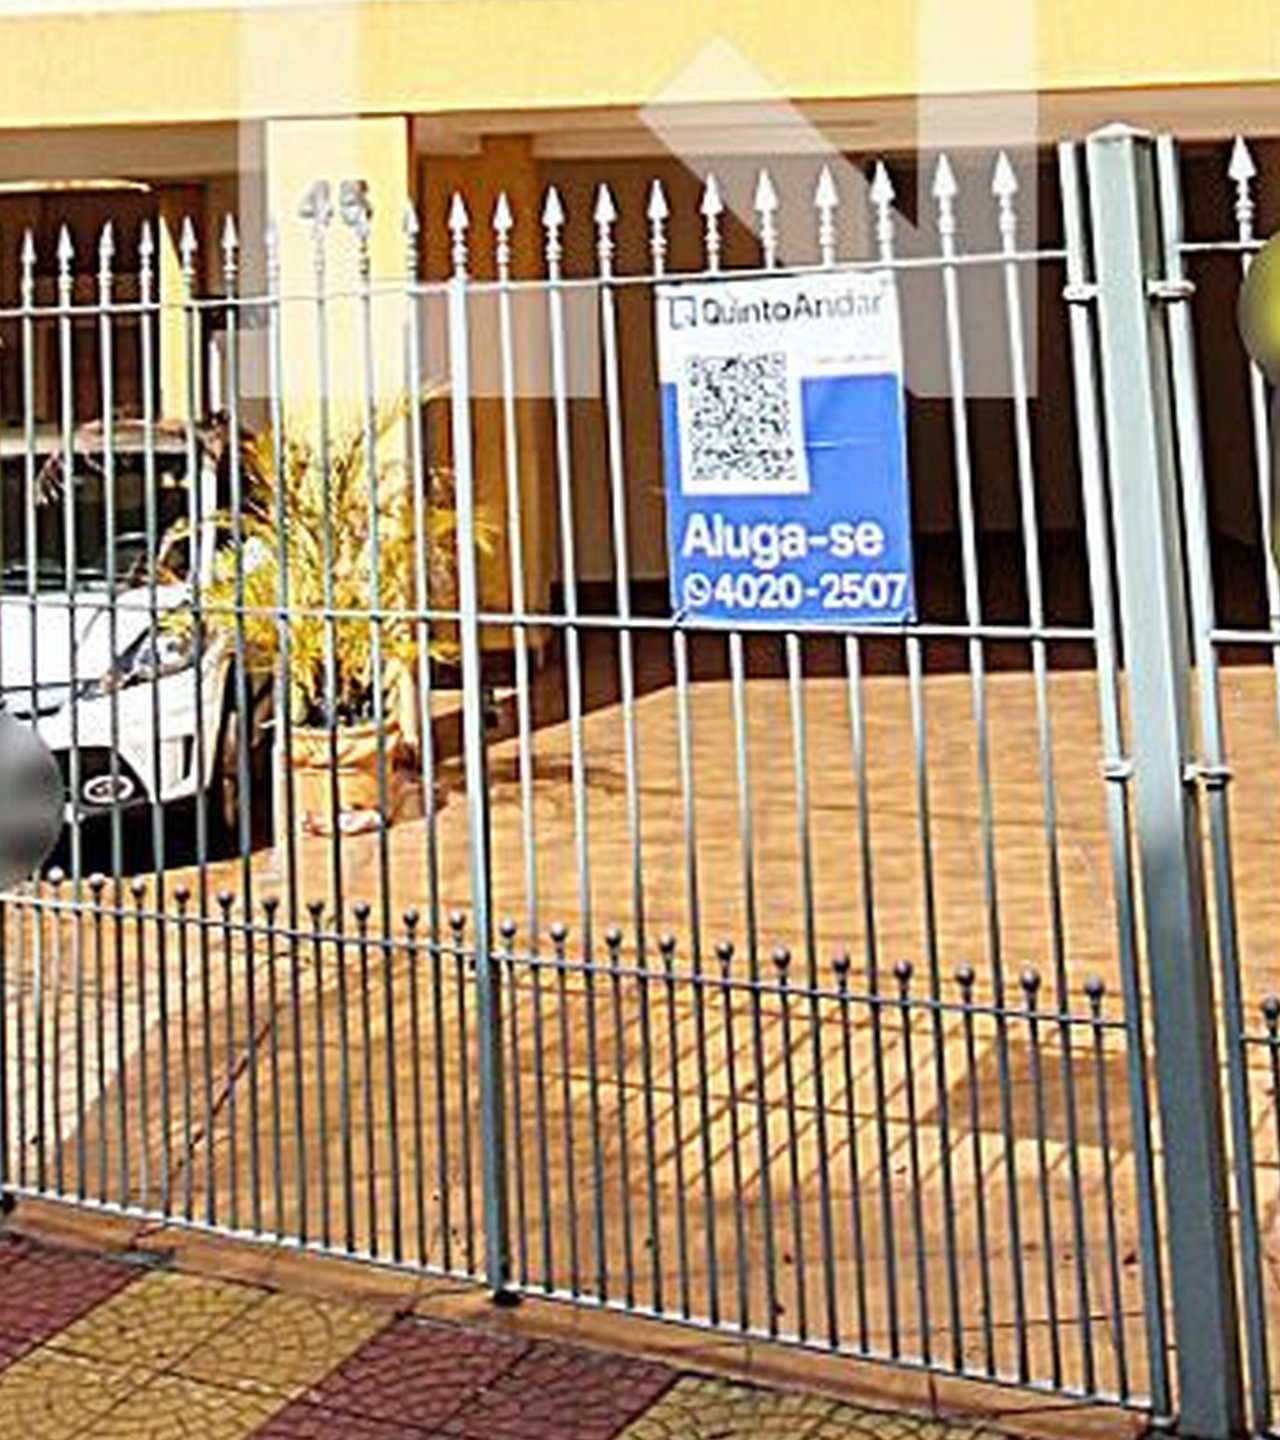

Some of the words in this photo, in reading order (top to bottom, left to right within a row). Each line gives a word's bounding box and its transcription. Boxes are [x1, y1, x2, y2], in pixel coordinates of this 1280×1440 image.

[701, 289, 883, 326] QuintoAndar
[681, 512, 885, 570] Aluga-se
[713, 572, 909, 610] 4020-2507
